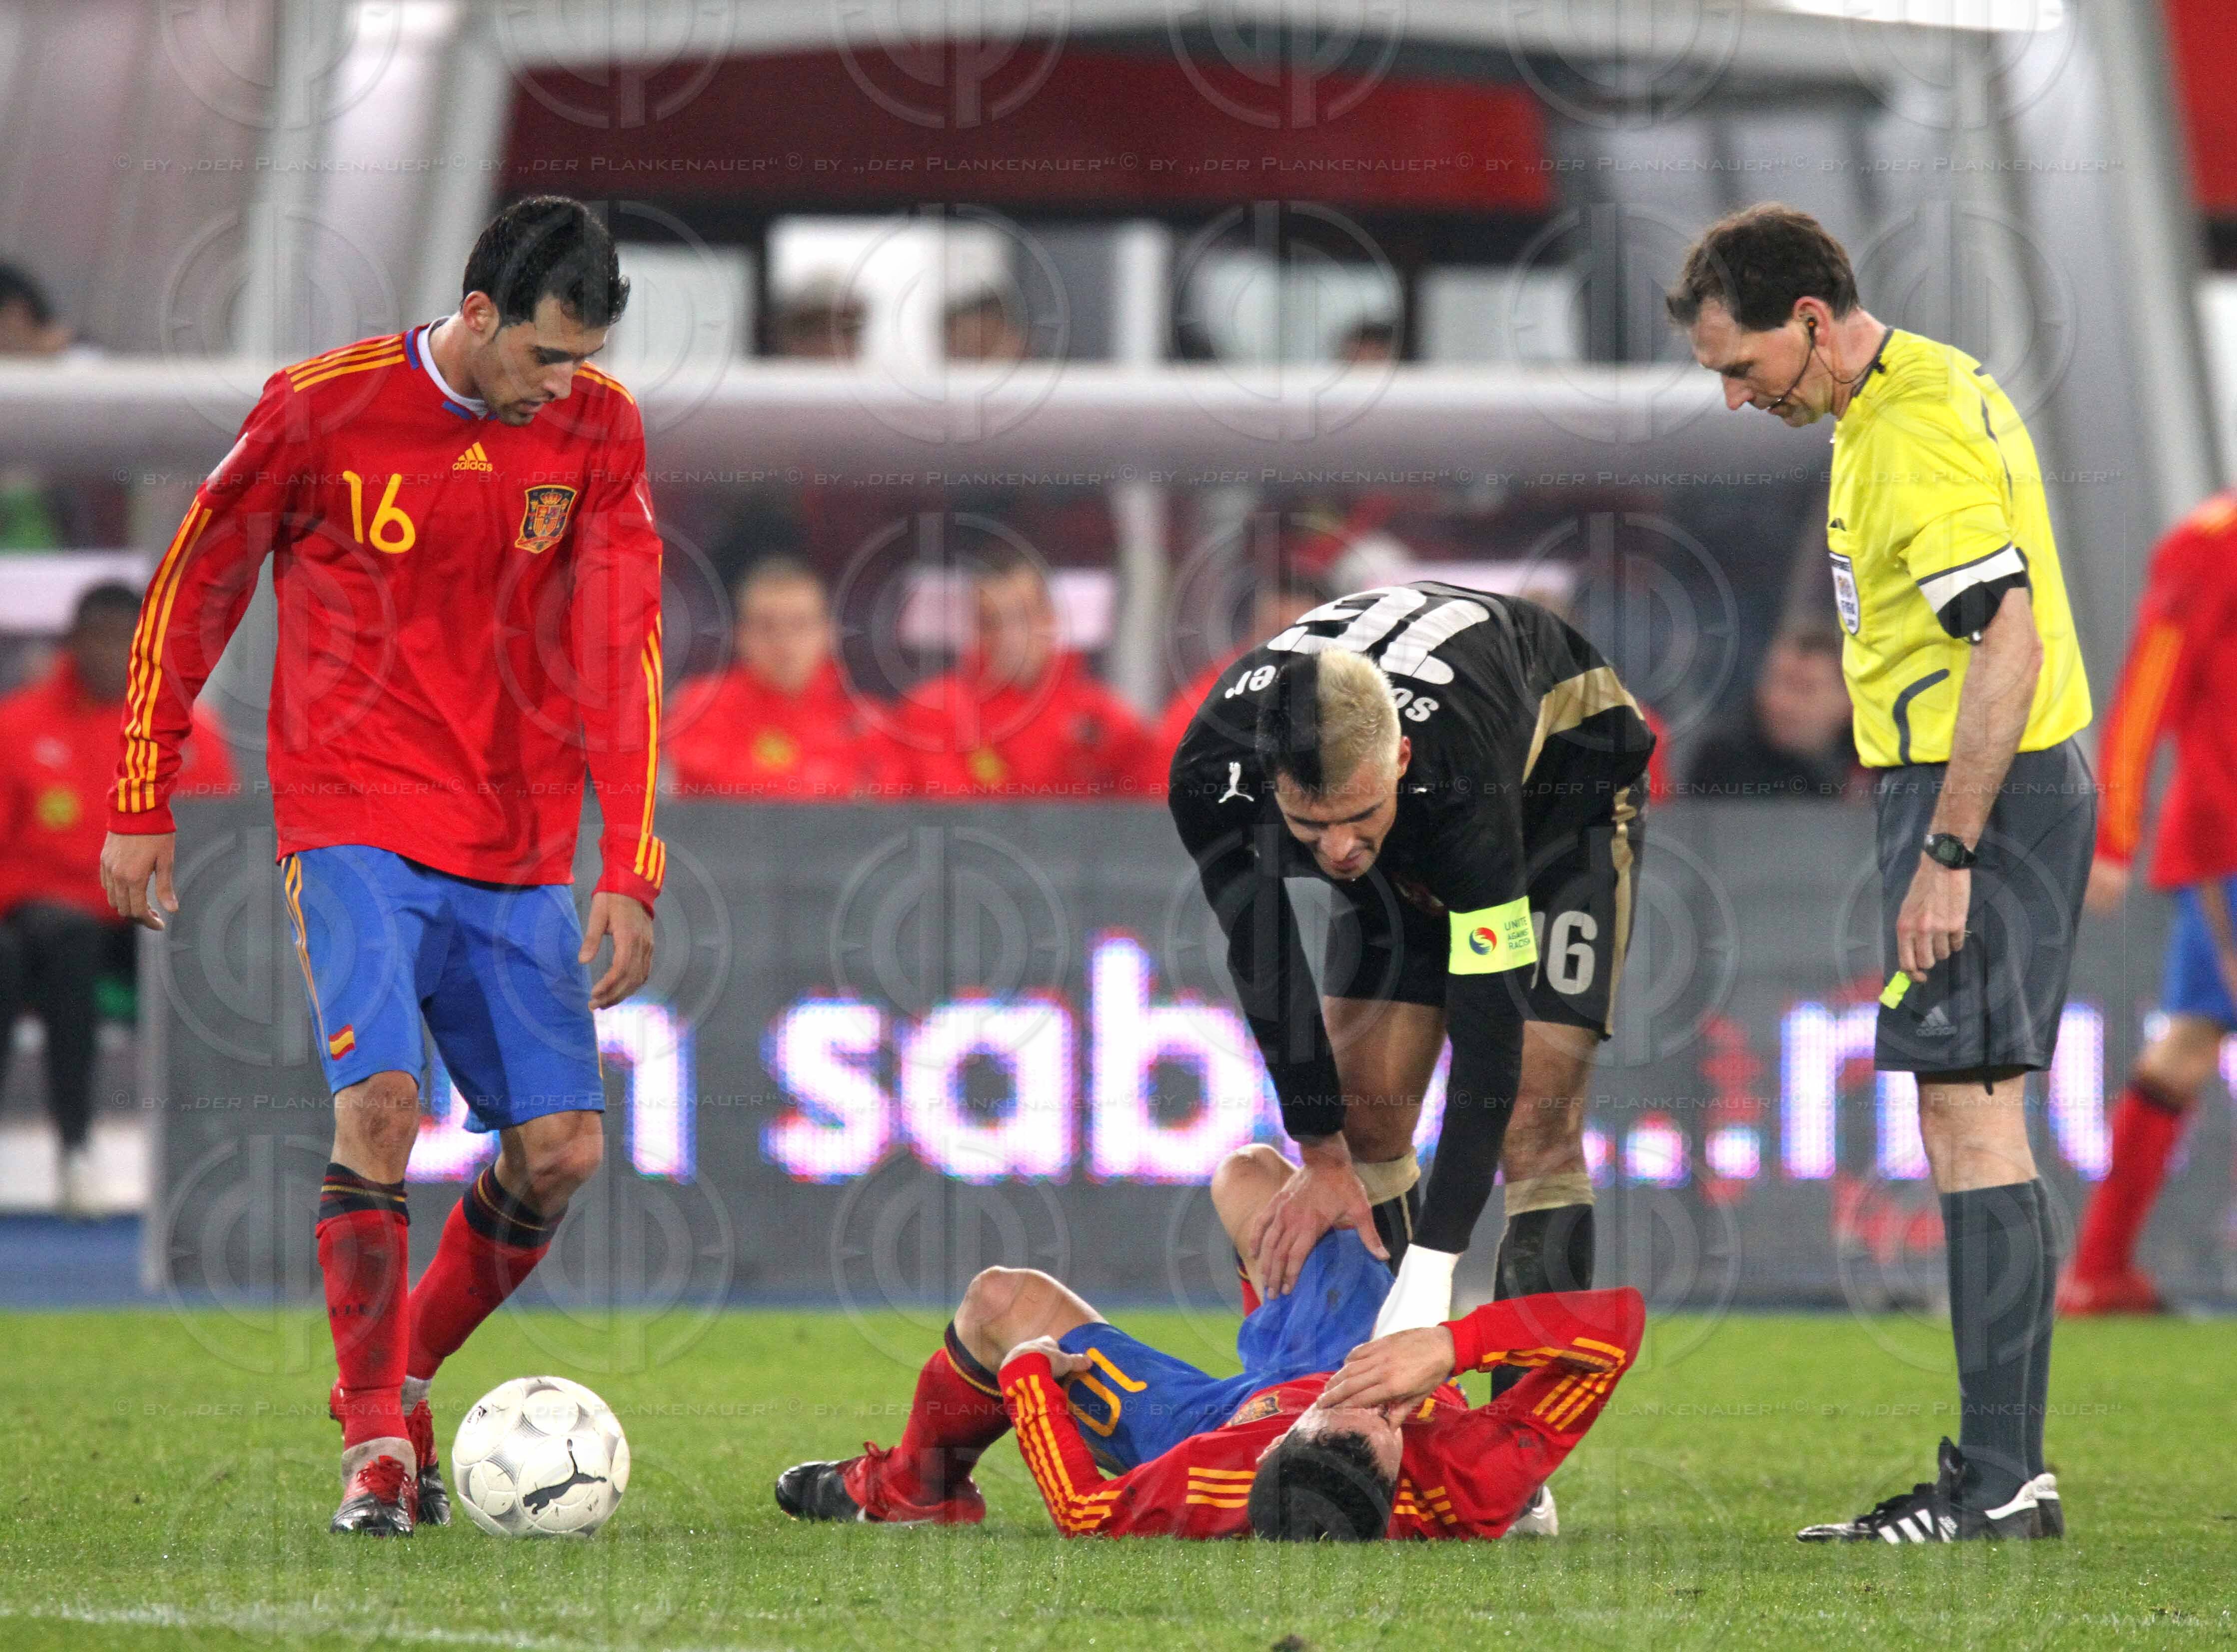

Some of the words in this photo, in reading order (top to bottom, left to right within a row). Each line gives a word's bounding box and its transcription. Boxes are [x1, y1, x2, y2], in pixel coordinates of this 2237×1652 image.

[452, 459, 493, 472] adidas
[342, 470, 416, 554] 16
[1503, 916, 1528, 931] UNITE
